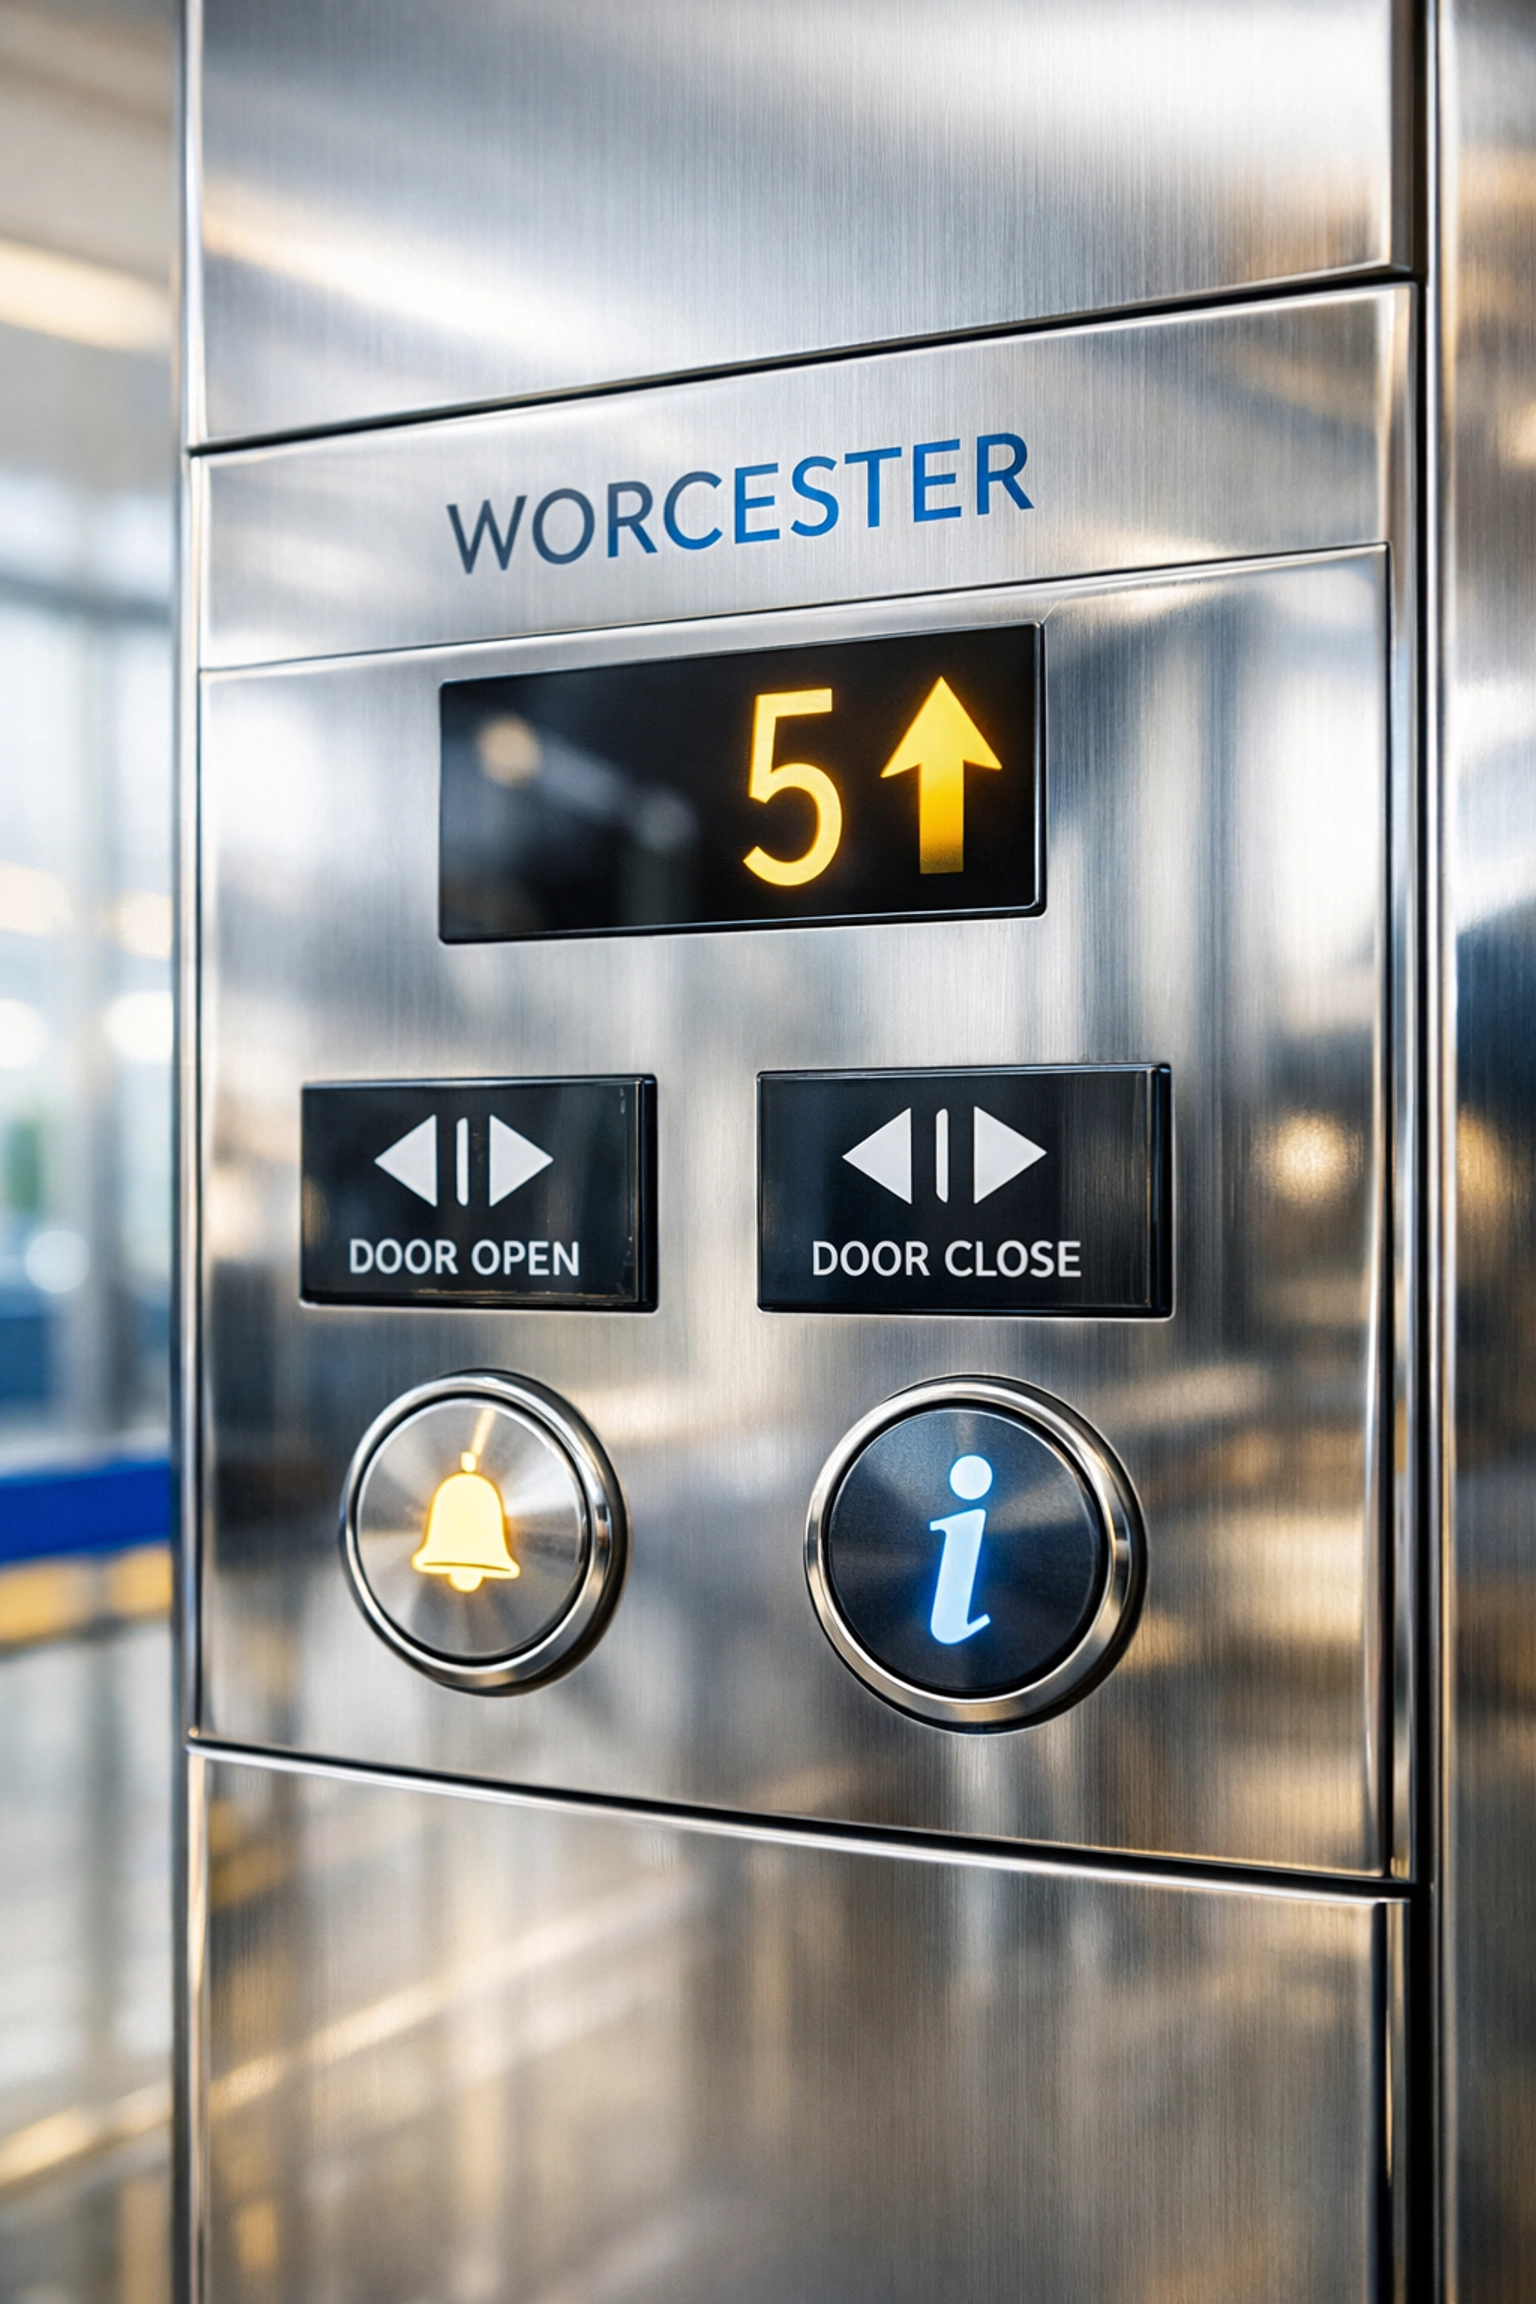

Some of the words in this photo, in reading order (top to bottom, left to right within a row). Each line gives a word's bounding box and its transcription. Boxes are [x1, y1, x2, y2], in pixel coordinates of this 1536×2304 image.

[446, 432, 1035, 575] WORCESTER
[742, 687, 843, 887] 5
[348, 1238, 458, 1277] DOOR
[471, 1239, 580, 1278] OPEN
[811, 1240, 931, 1279] DOOR
[944, 1240, 1082, 1280] CLOSE
[928, 1453, 993, 1645] i
